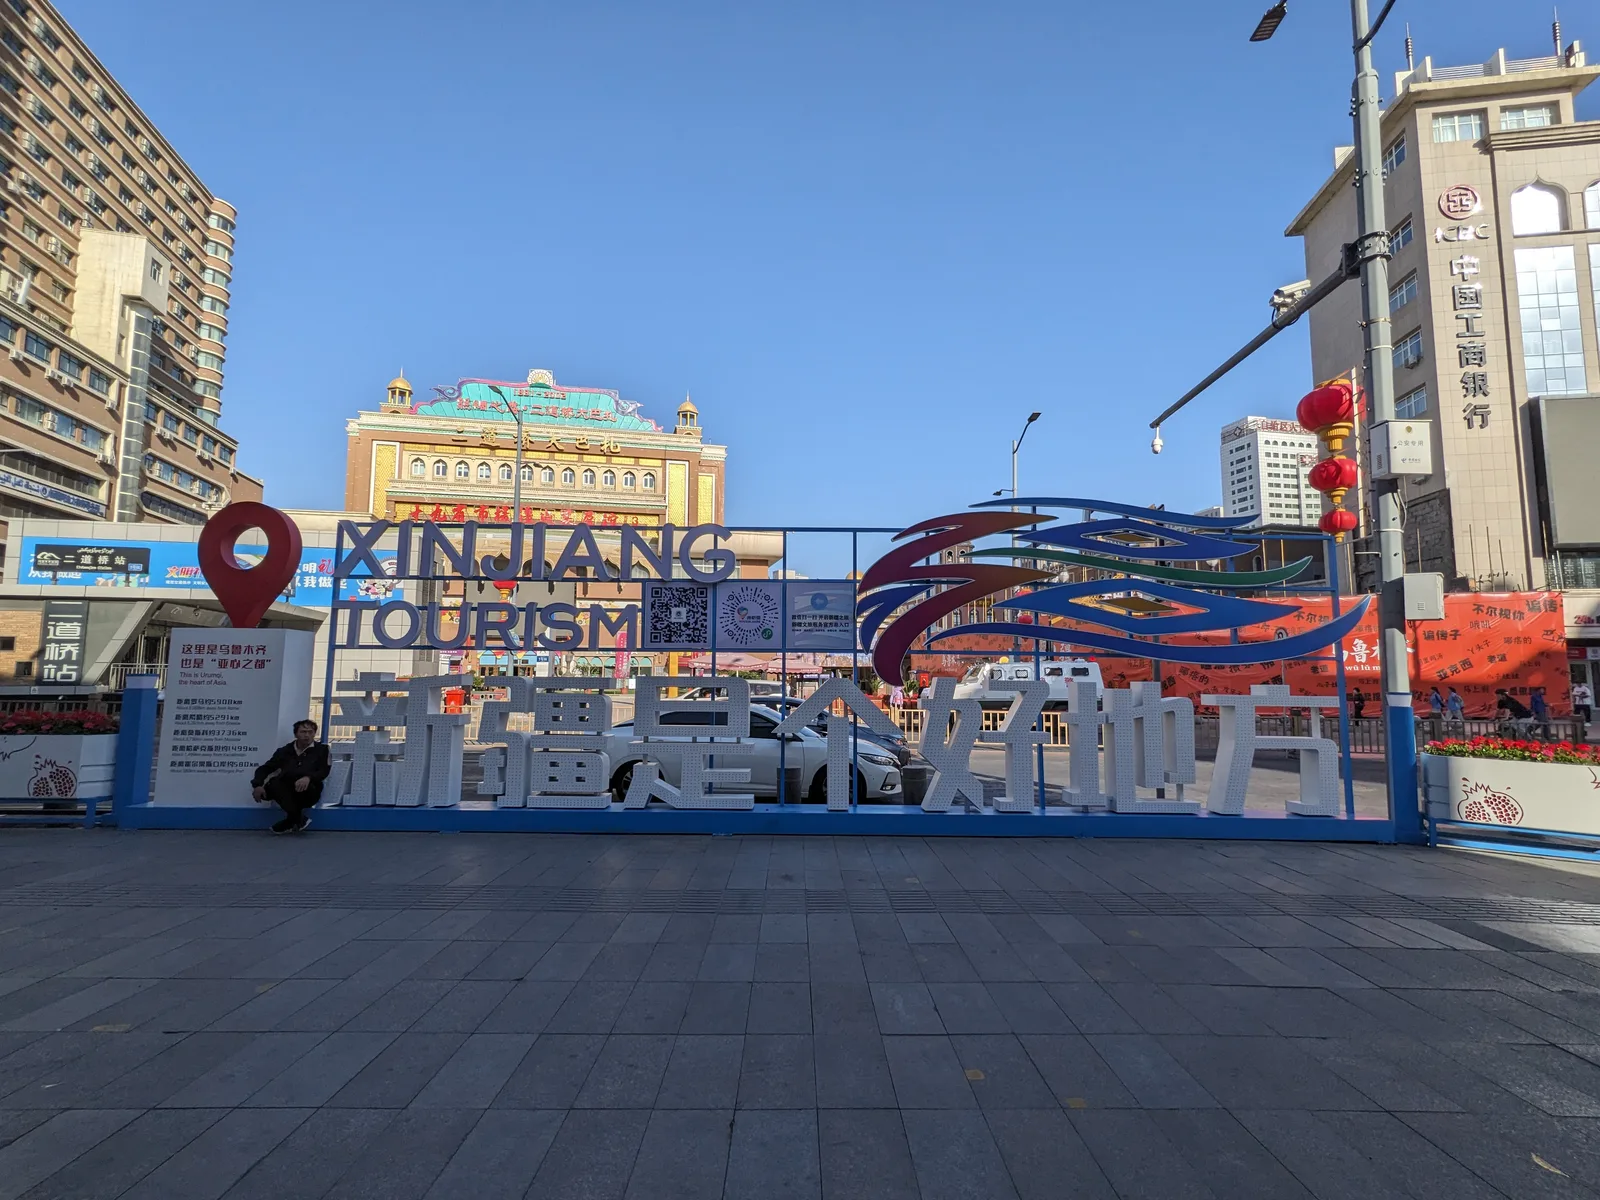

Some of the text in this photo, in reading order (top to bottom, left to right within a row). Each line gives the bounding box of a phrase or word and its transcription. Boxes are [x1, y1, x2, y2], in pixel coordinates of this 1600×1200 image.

[1434, 223, 1490, 243] ICBC
[1449, 254, 1491, 430] 中国工商银行
[1261, 420, 1310, 434] 自治区人
[63, 554, 126, 566] 二道桥站
[337, 519, 736, 583] XINJIANG
[43, 601, 82, 682] 二道桥站
[332, 600, 638, 651] TOURISM
[181, 644, 267, 655] 这里是乌鲁木齐
[1435, 657, 1473, 681] 亚克西
[322, 671, 1341, 817] 新疆是个好地方
